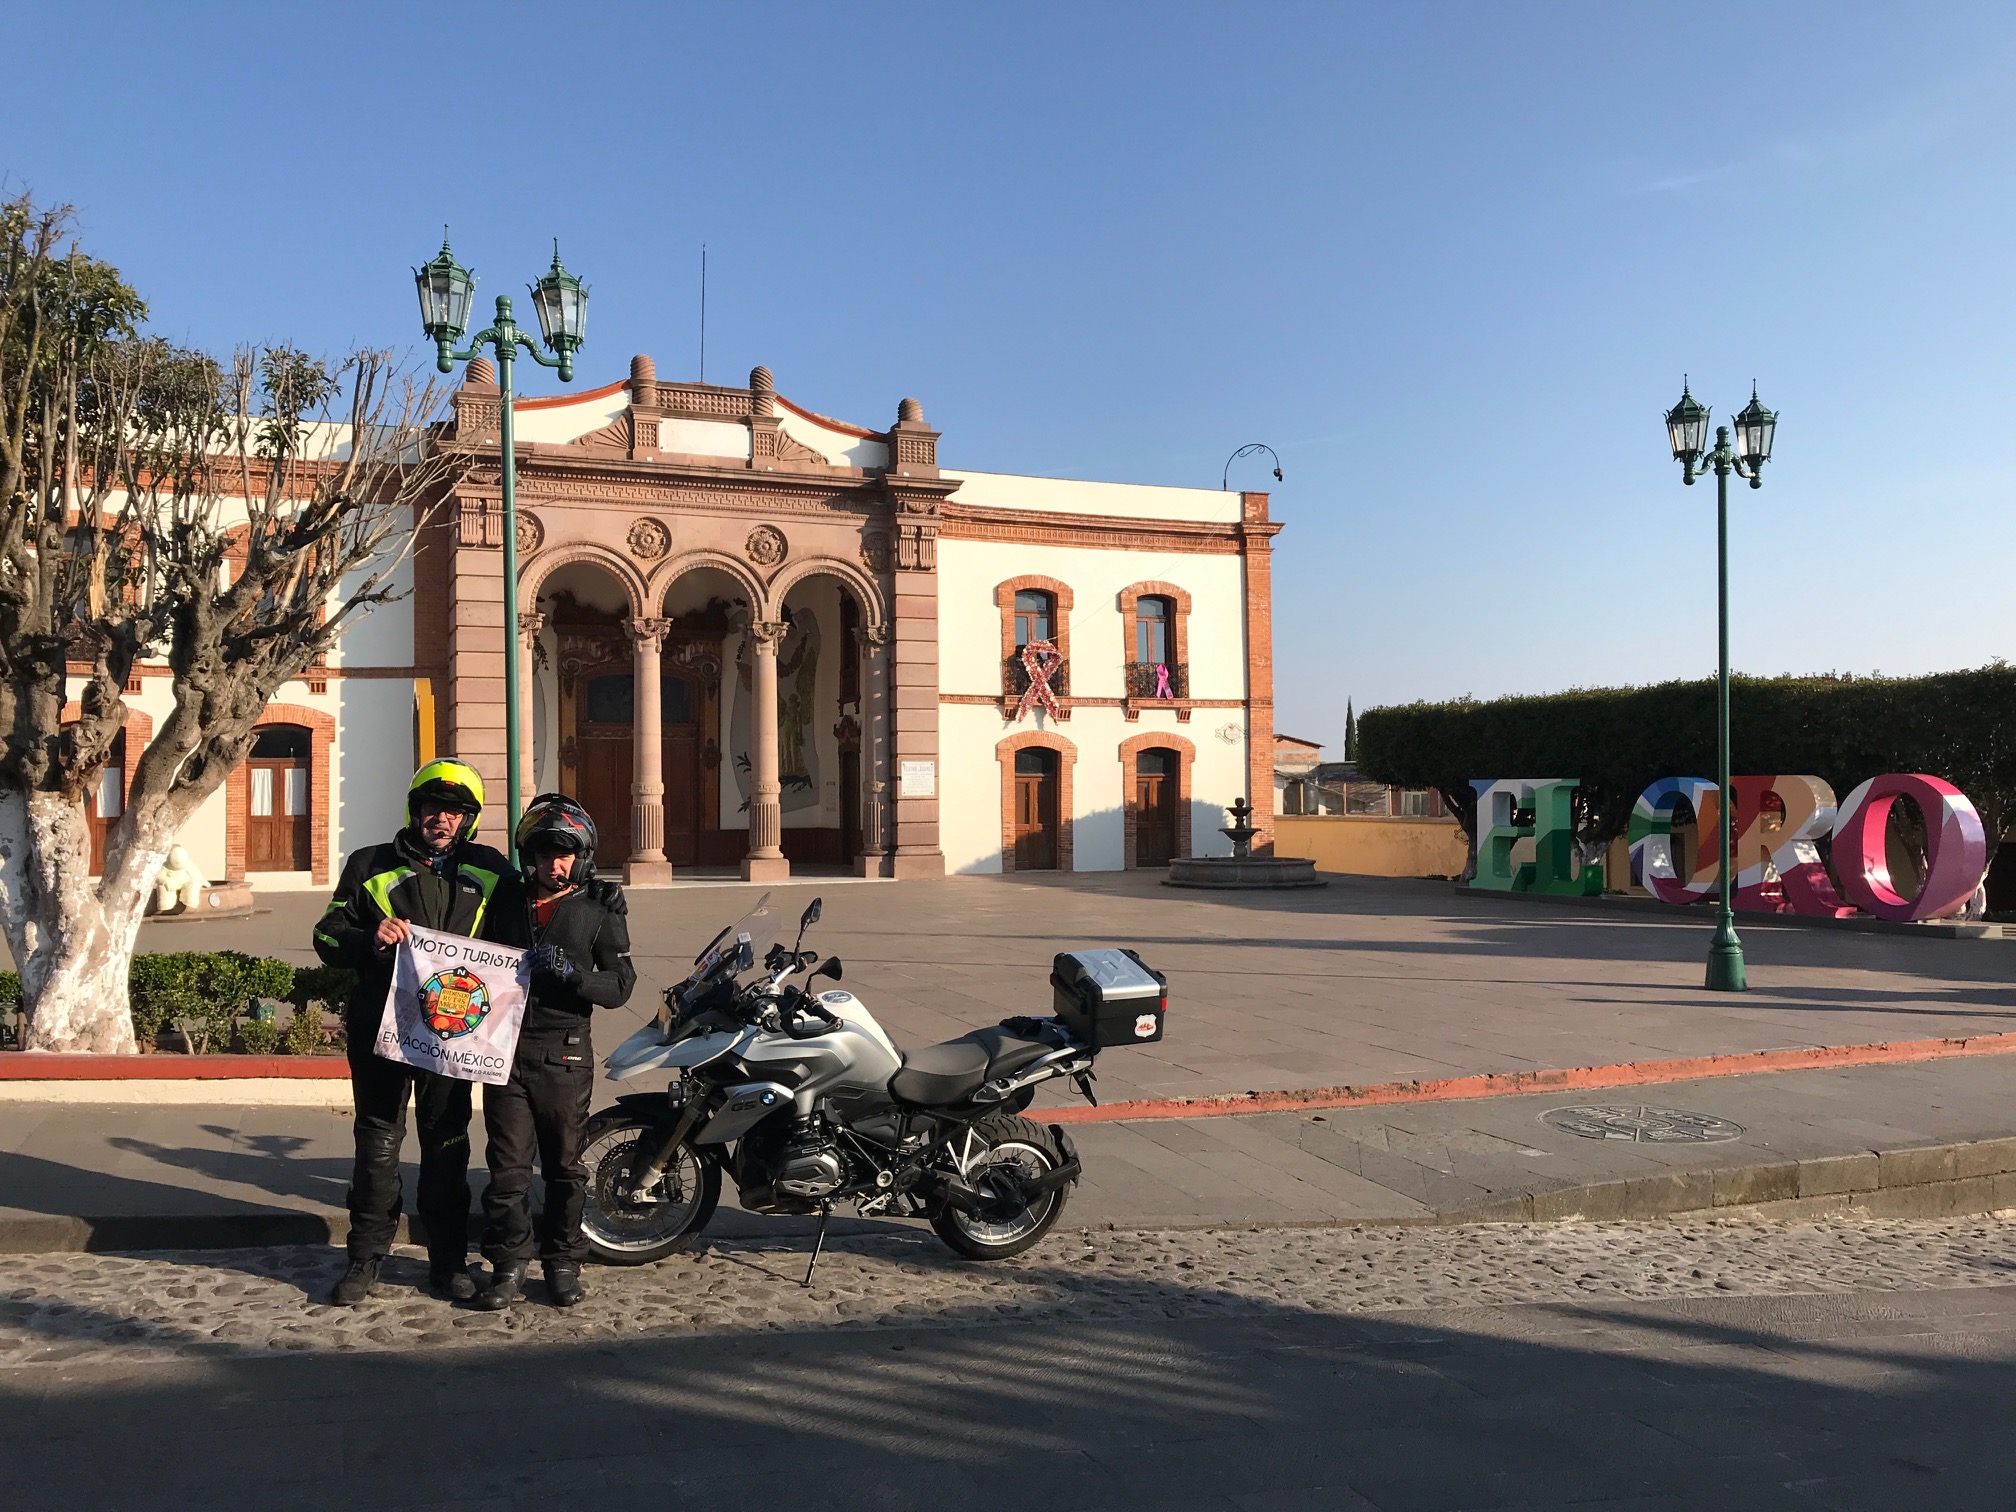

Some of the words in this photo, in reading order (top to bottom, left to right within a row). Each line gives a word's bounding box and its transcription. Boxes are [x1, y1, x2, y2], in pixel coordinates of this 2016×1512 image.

[1468, 778, 1604, 897] EL
[1628, 773, 1987, 921] ORO
[409, 935, 458, 958] MOTO
[462, 947, 520, 970] TURISTA
[382, 1031, 400, 1044] EN
[402, 1035, 451, 1061] ACCIÓN
[452, 1050, 505, 1069] MÉXICO
[731, 1101, 757, 1112] GS
